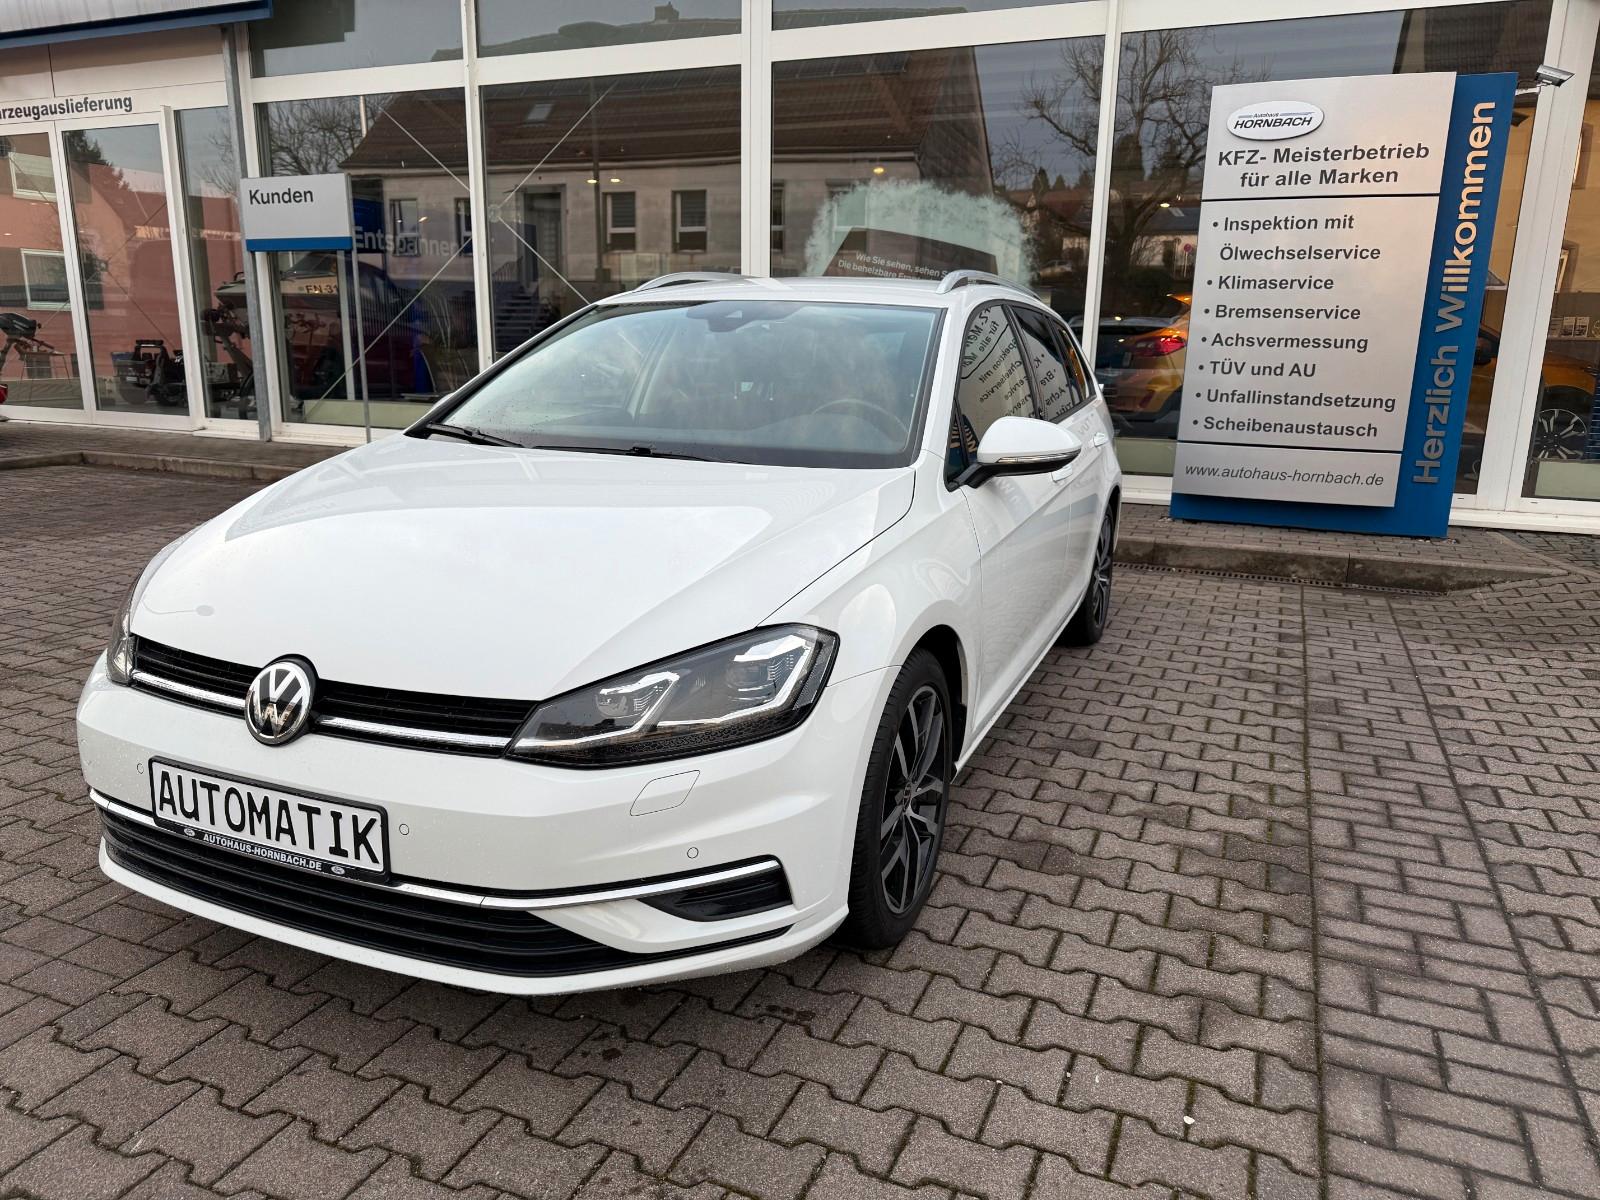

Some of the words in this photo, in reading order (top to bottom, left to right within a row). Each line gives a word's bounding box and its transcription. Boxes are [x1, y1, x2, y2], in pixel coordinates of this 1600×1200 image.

[0, 96, 133, 121] rzeugauslieferung
[1233, 116, 1313, 129] HORNBACH
[1218, 149, 1267, 166] KFZ-
[1273, 142, 1430, 164] Meisterbetrieb
[1240, 172, 1269, 188] für
[1275, 170, 1312, 186] alle
[1318, 167, 1399, 185] Marken
[249, 187, 314, 205] Kunden
[1224, 215, 1318, 235] Inspektion
[1324, 214, 1355, 230] mit
[1434, 101, 1497, 333] Willkommen
[1219, 242, 1381, 261] Ölwechselservice
[1218, 275, 1334, 290] Klimaservice
[1215, 304, 1361, 320] Bremsenservice
[1211, 332, 1369, 354] Achsvermessung
[1209, 358, 1246, 375] TÜV
[1251, 362, 1285, 377] und
[1288, 363, 1316, 378] AU
[1207, 388, 1396, 413] Unfallinstandsetzung
[1412, 345, 1459, 484] Herzlich
[1203, 416, 1378, 438] Scheibenaustausch
[1185, 464, 1384, 486] www.autohaus-hornbach.de
[158, 769, 380, 865] AUTOMATIK
[202, 832, 323, 872] AUTOHAUS-HORNBACH.DE
